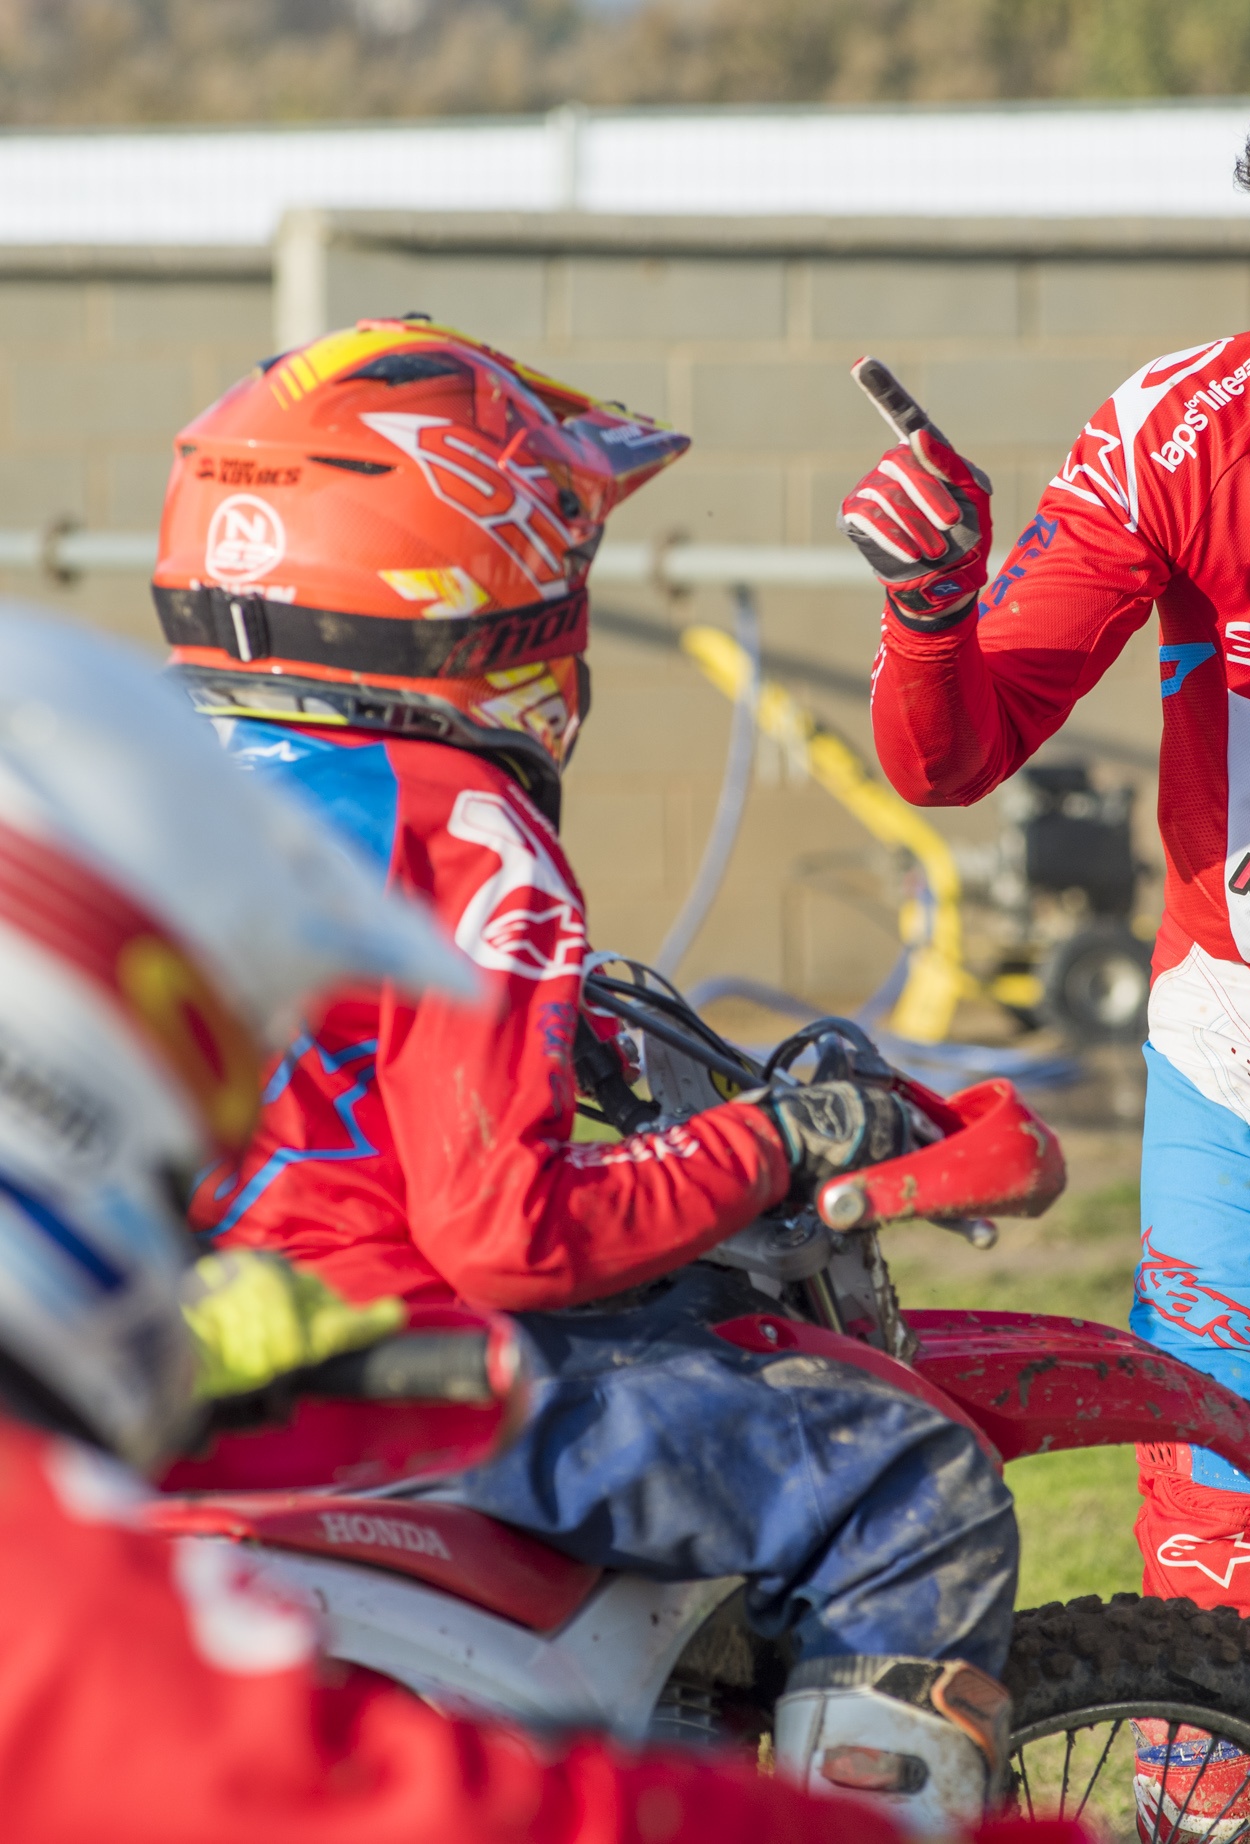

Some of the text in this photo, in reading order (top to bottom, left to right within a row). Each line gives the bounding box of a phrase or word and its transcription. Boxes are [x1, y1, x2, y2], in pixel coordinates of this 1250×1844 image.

[1150, 408, 1208, 473] laps
[1195, 376, 1245, 411] life
[319, 1511, 452, 1562] HONDA
